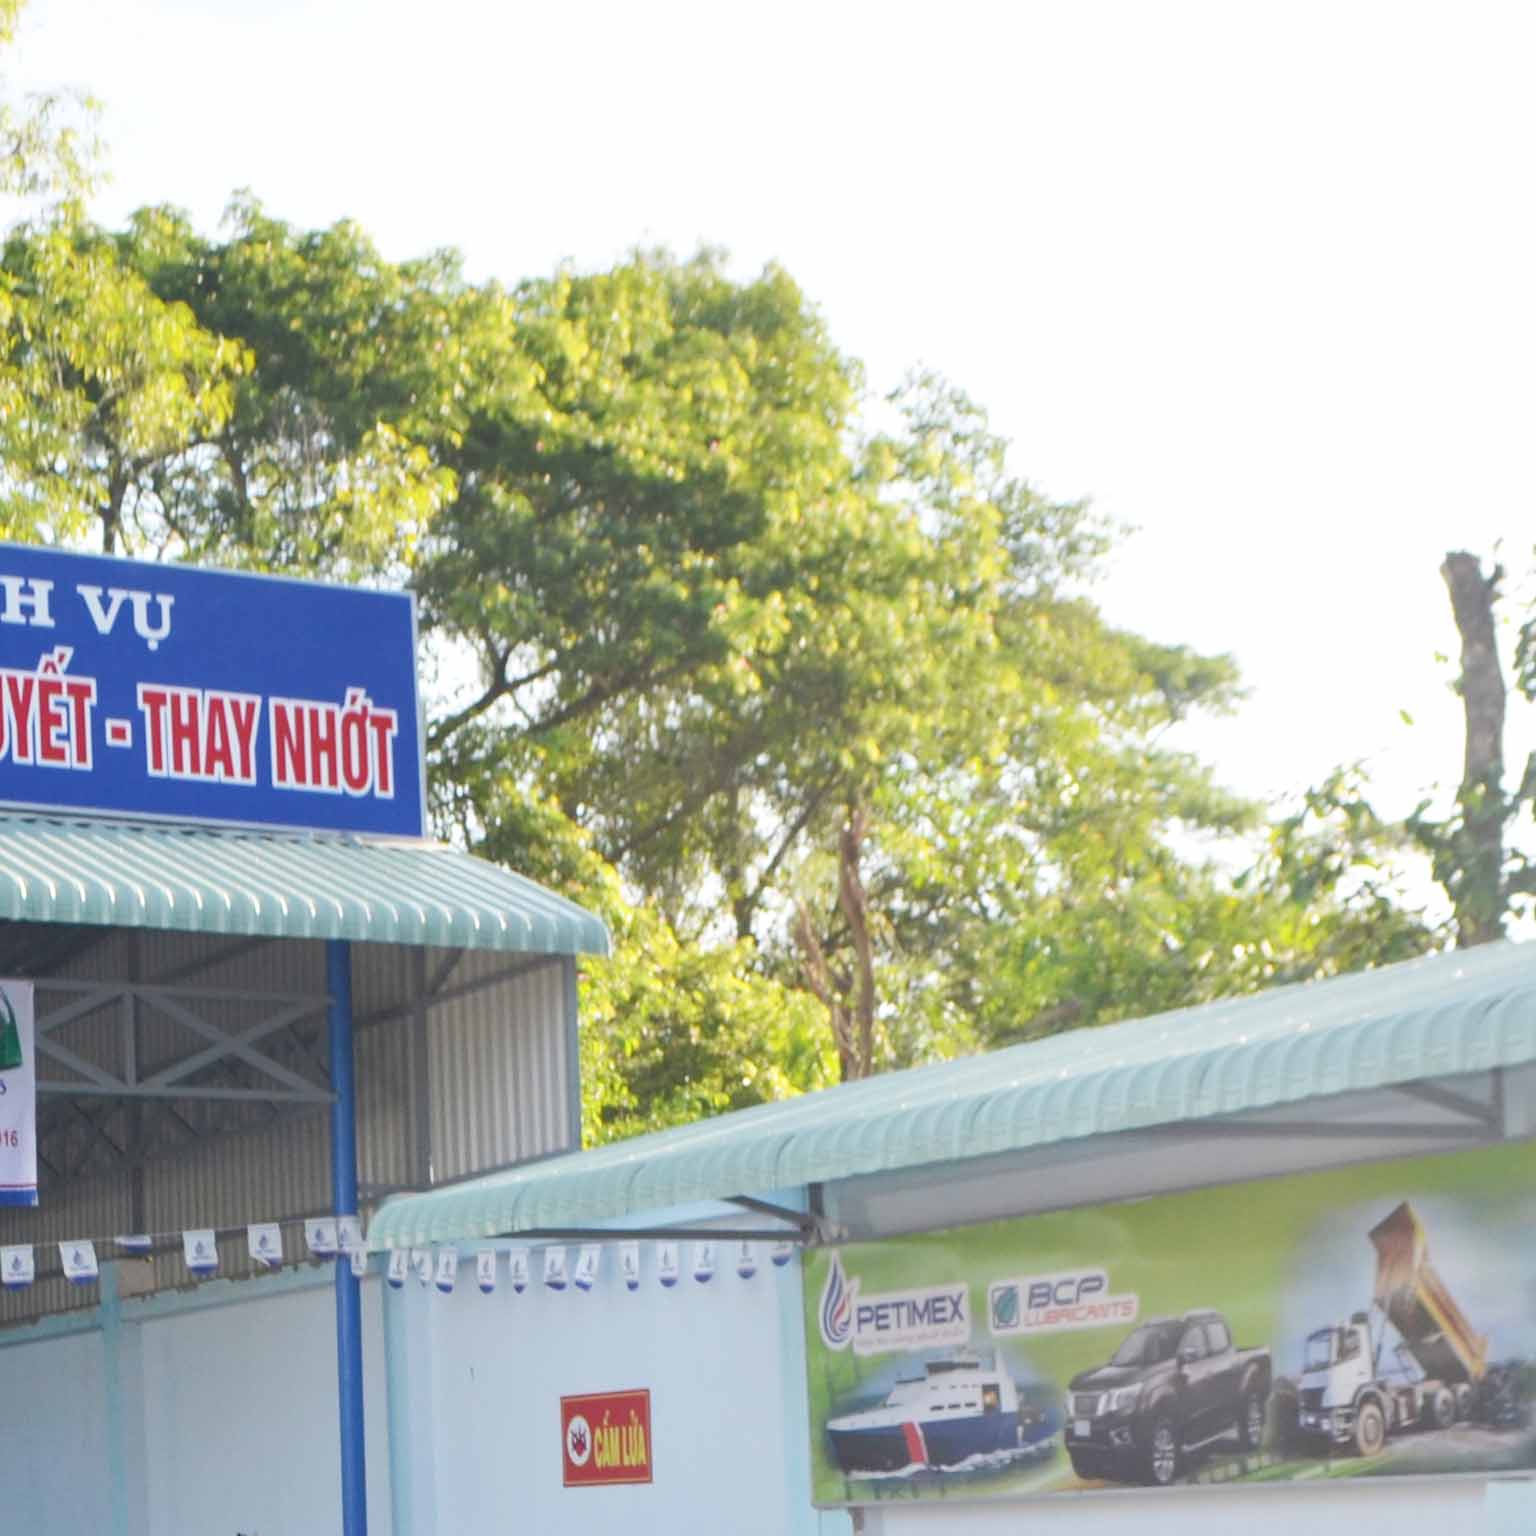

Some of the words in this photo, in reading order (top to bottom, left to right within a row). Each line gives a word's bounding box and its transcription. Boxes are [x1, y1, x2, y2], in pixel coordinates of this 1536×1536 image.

[76, 585, 174, 650] VỤ
[137, 682, 260, 785] THAY
[269, 686, 397, 799] NHỚT
[857, 1292, 965, 1332] PETIMEX
[1023, 1300, 1135, 1328] LUBRICANTS
[1027, 1274, 1105, 1309] BCP
[594, 1409, 620, 1471] CẤM
[622, 1409, 646, 1467] LỬA
